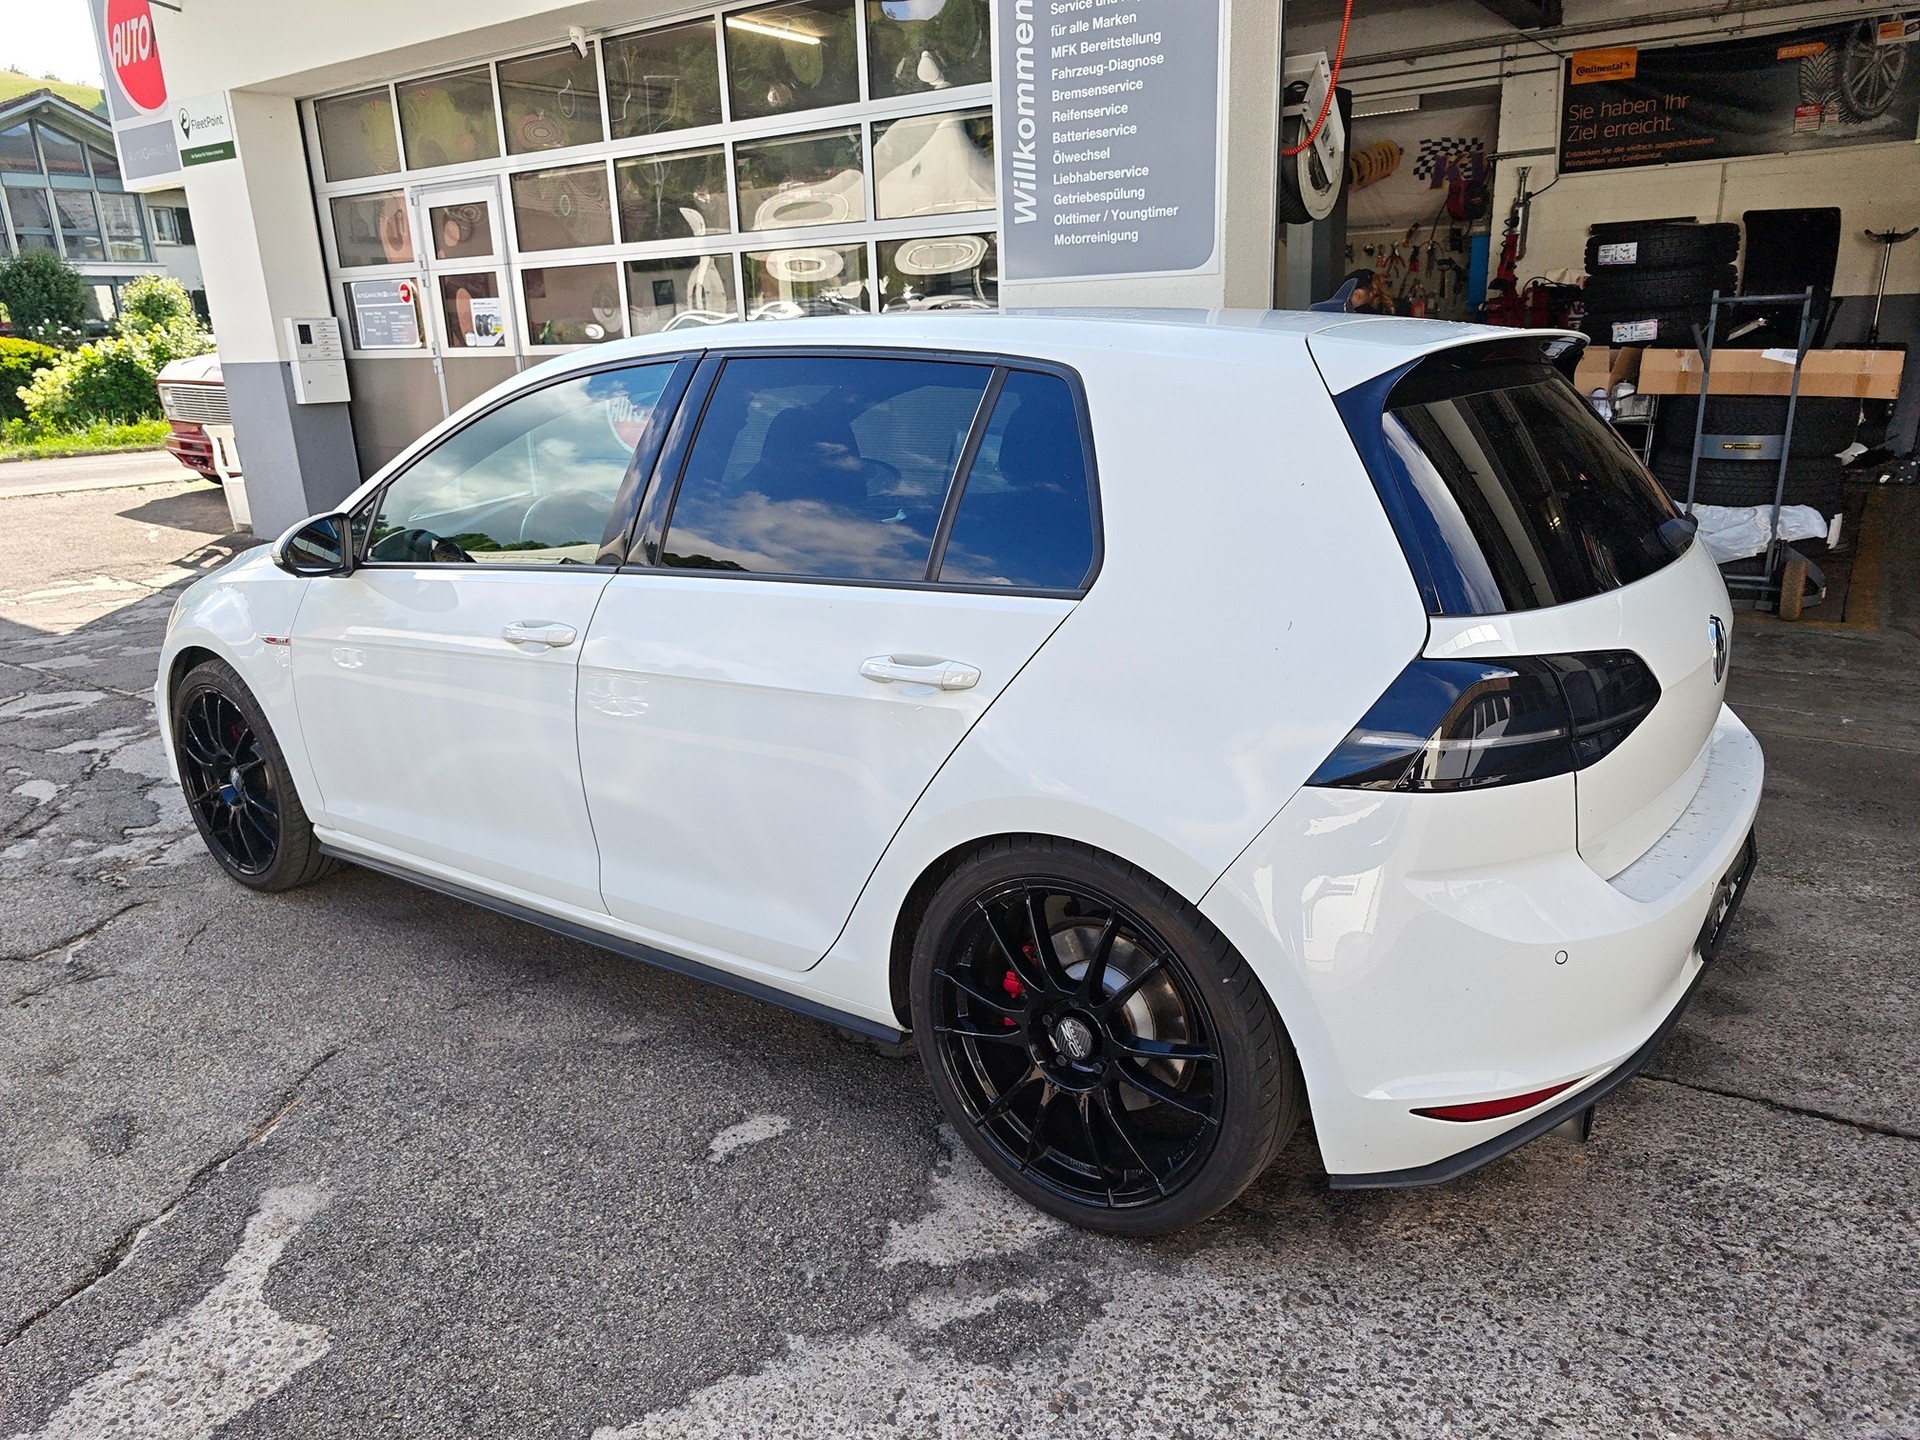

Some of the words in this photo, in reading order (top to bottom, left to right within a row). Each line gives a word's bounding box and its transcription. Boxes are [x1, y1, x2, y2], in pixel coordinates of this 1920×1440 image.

[1050, 0, 1092, 15] Service
[1050, 25, 1067, 37] für
[1069, 20, 1089, 34] alle
[1092, 13, 1137, 30] Marken
[112, 14, 150, 67] AUTO
[1051, 43, 1078, 59] MFK
[1080, 31, 1162, 54] Bereitstellung
[1051, 53, 1165, 80] Fahrzeug-Diagnose
[1576, 62, 1623, 77] Continental
[1051, 79, 1144, 101] Bremsenservice
[1012, 0, 1037, 224] Willkommen
[1052, 103, 1129, 123] Reifenservice
[1568, 104, 1594, 121] Sie
[1600, 99, 1657, 118] haben
[1665, 94, 1690, 110] Ihr
[191, 115, 224, 131] FleetPoint
[1567, 124, 1598, 142] Ziel
[1603, 115, 1676, 138] erreicht.
[1052, 124, 1137, 144] Batterieservice
[1052, 147, 1111, 165] Ölwechsel
[1053, 165, 1150, 186] Liebhaberservice
[1053, 187, 1146, 206] Getriebespülung
[1053, 210, 1101, 226] Oldtimer
[1103, 210, 1109, 221] /
[1111, 205, 1179, 222] Youngtimer
[1054, 230, 1139, 246] Motorreinigung
